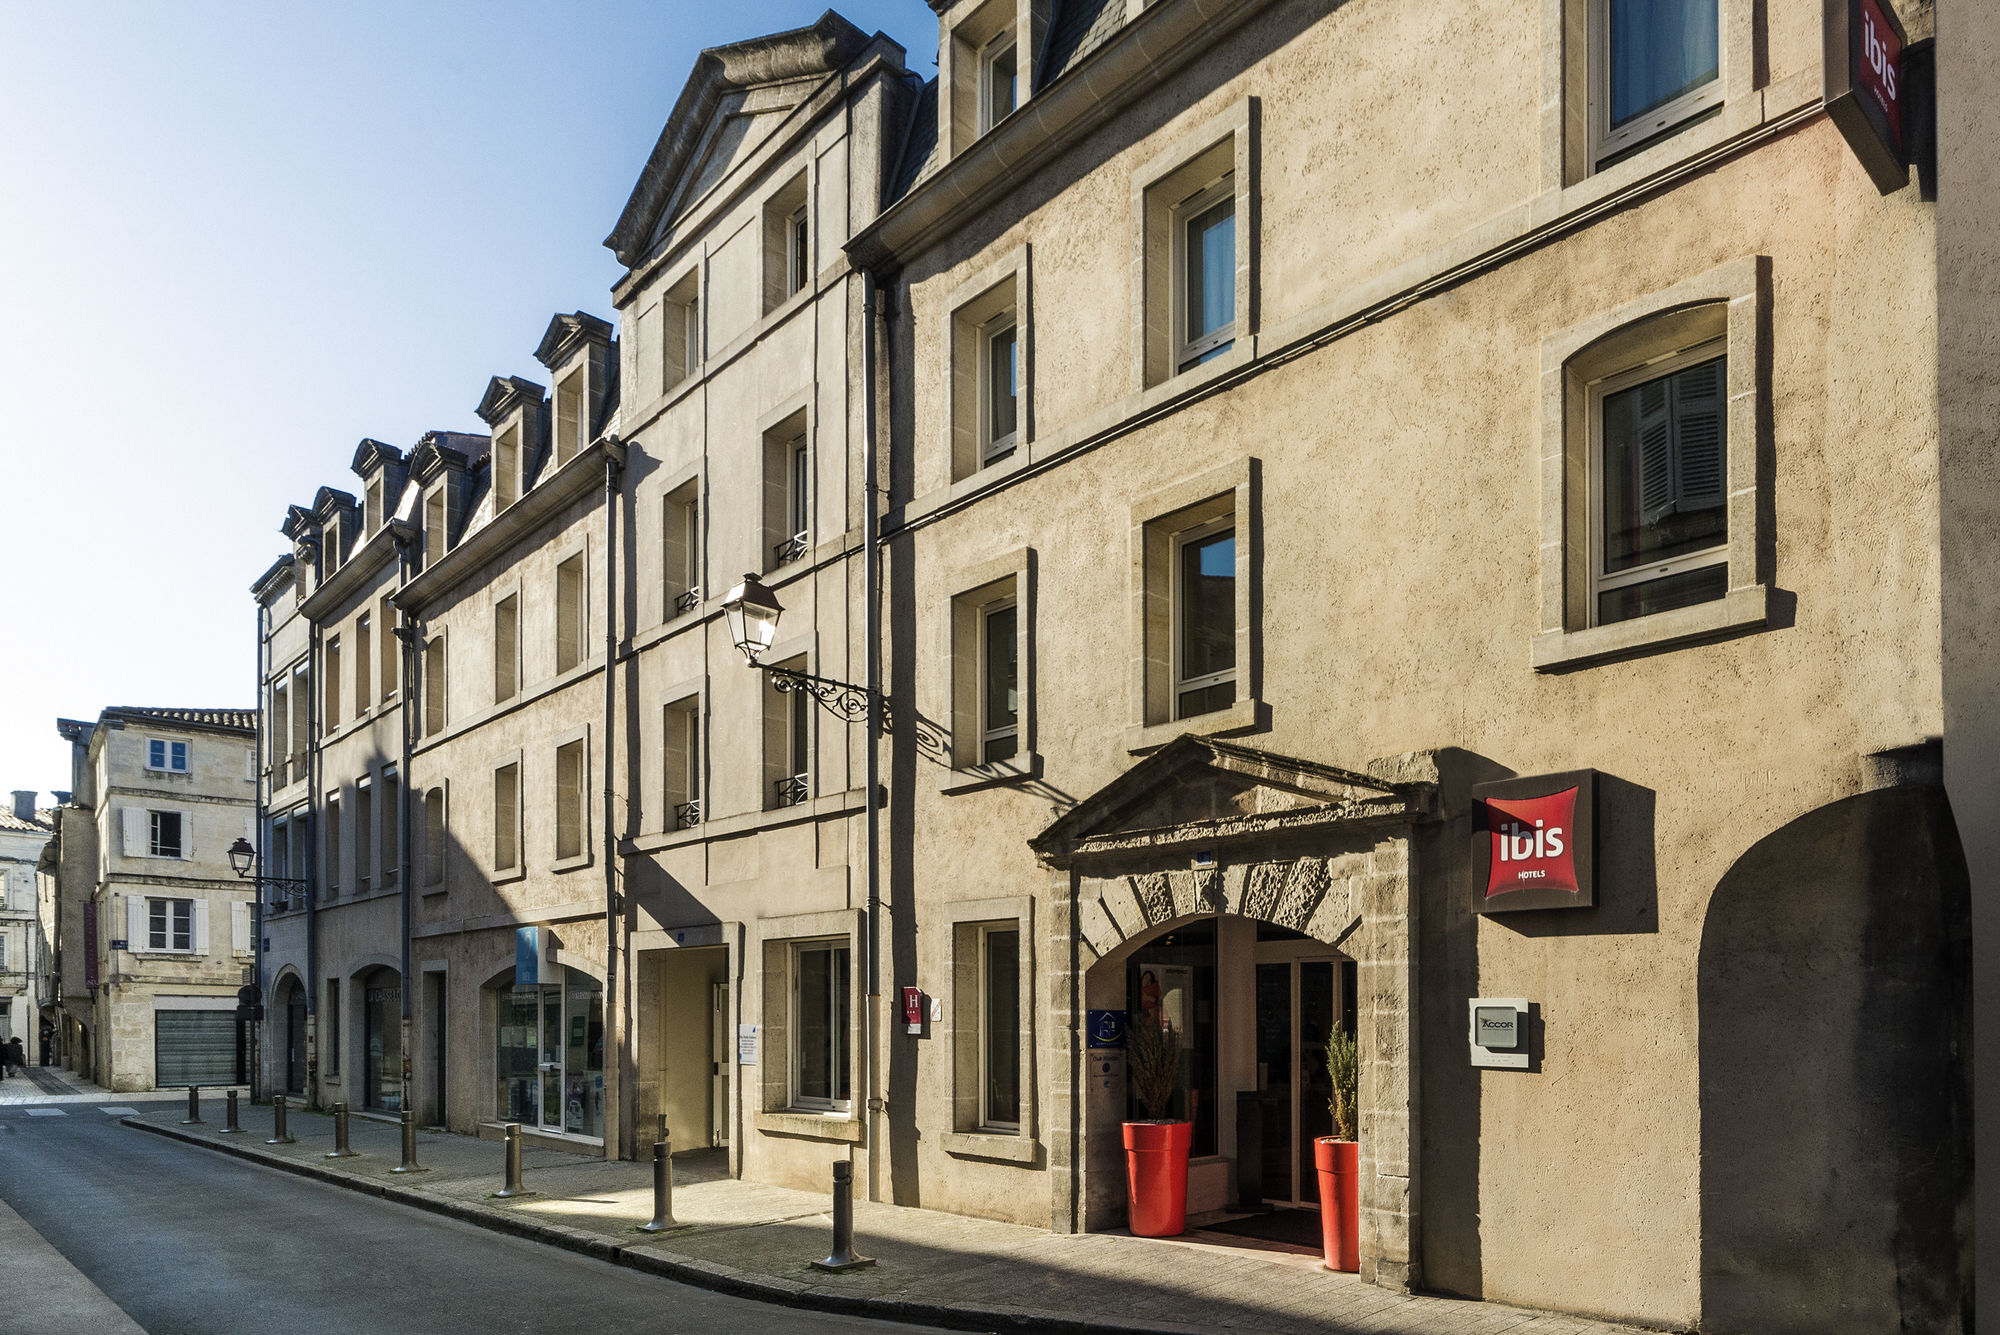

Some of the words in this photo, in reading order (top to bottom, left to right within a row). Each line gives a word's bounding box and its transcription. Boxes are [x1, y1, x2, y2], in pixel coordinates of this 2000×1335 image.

[1865, 9, 1896, 100] ibis
[1501, 819, 1564, 861] ibis
[1518, 870, 1545, 879] HOTELS
[909, 994, 918, 1008] H
[1482, 1021, 1514, 1029] ACCOR
